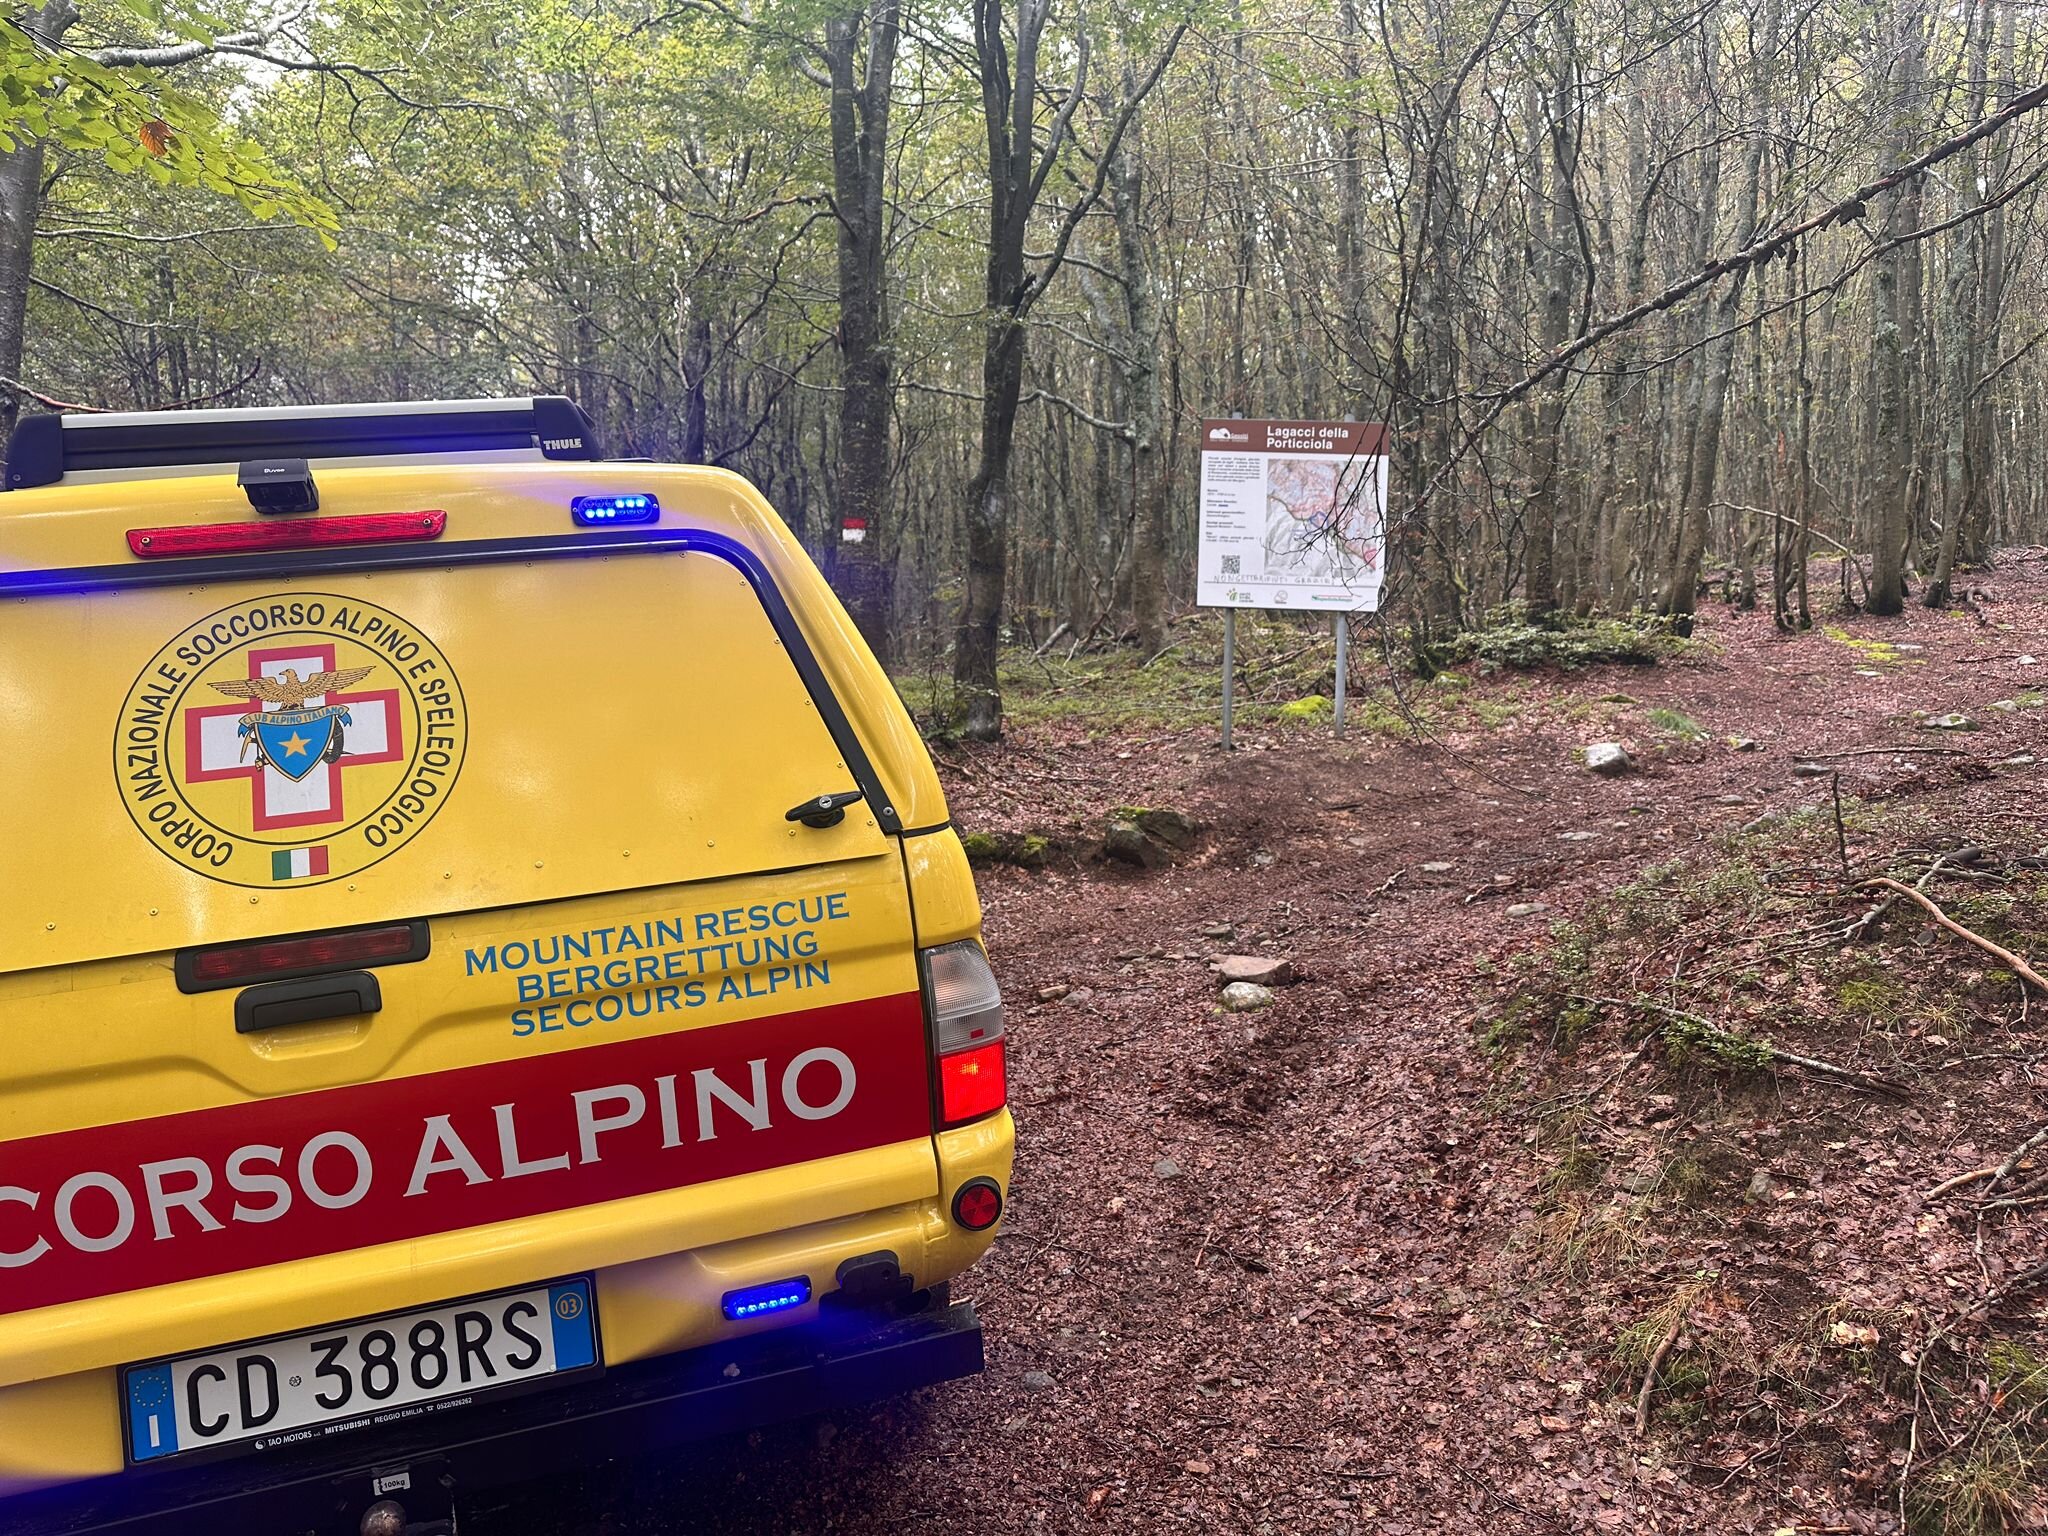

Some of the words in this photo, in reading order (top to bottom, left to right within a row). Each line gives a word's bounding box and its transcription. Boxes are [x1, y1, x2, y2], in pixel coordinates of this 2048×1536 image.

[543, 438, 582, 450] THULE
[1267, 426, 1315, 438] Lagacci
[1319, 427, 1349, 438] della
[1267, 438, 1333, 449] Porticciola
[176, 603, 325, 667] SOCCORSO
[330, 607, 420, 662] ALPINO
[408, 659, 436, 680] E
[127, 663, 186, 802] NAZIONALE
[243, 714, 267, 725] CLUB
[269, 715, 303, 724] ALPINO
[304, 707, 344, 721] ITALIANO
[364, 677, 455, 848] SPELEOLOGICO
[149, 801, 233, 866] CORPO
[464, 916, 683, 977] MOUNTAIN
[694, 892, 850, 940] RESCUE
[516, 930, 819, 1004] BERGRETTUNG
[511, 979, 707, 1037] SECOURS
[716, 960, 831, 1004] ALPIN
[403, 1047, 857, 1197] ALPINO
[560, 1297, 578, 1315] 03
[186, 1354, 280, 1437] CD
[310, 1300, 542, 1410] 388RS
[267, 1436, 282, 1447] TAO
[283, 1430, 312, 1444] MOTORS
[324, 1418, 371, 1435] MITSUBISHI
[374, 1412, 401, 1424] REGGIO
[401, 1407, 424, 1419] EMILIA
[384, 1480, 405, 1489] 100kg
